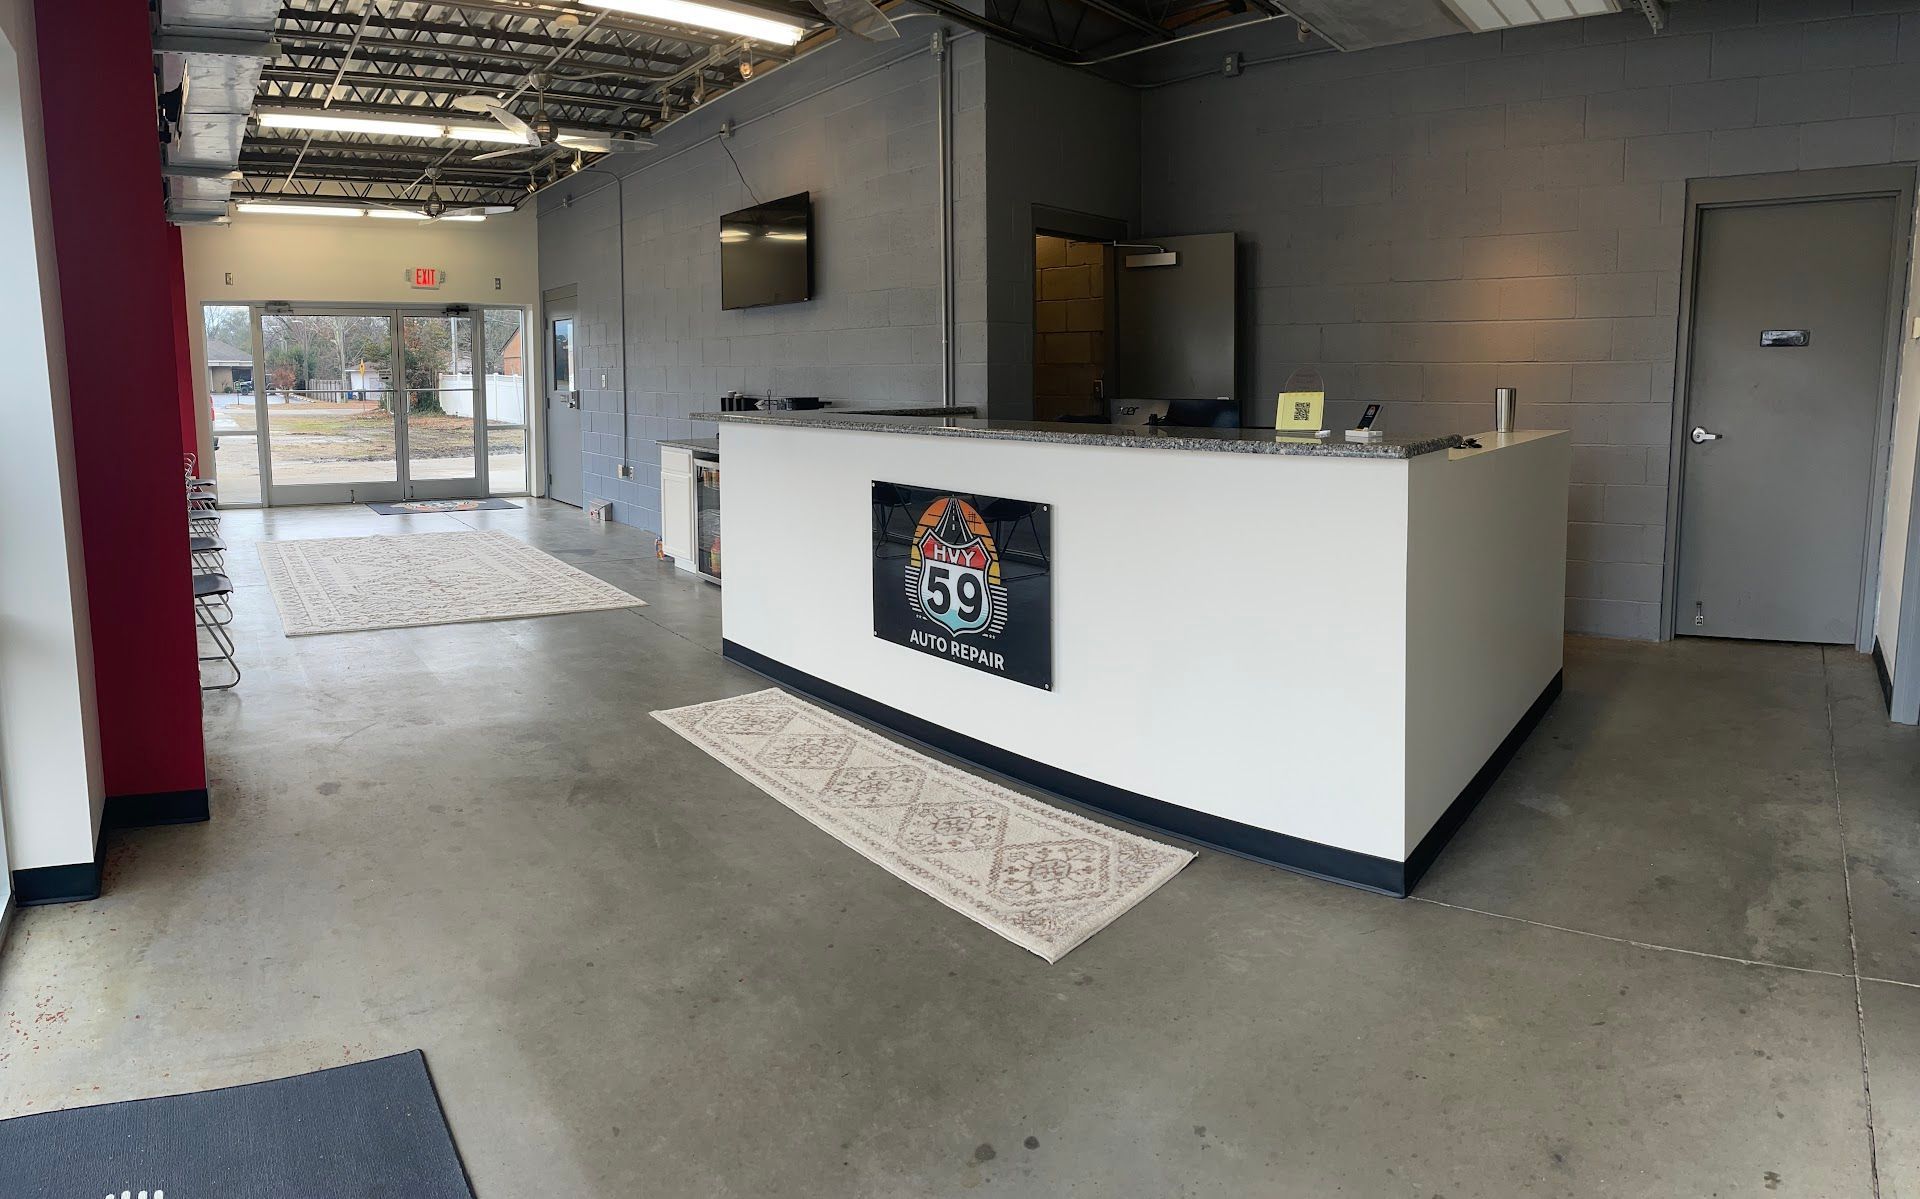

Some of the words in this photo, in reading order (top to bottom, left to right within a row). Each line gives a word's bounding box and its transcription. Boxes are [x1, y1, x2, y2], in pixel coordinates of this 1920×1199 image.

[416, 268, 435, 286] EXIT
[926, 565, 983, 623] 59
[909, 628, 948, 653] AUTO
[950, 640, 1005, 671] REPAIR
